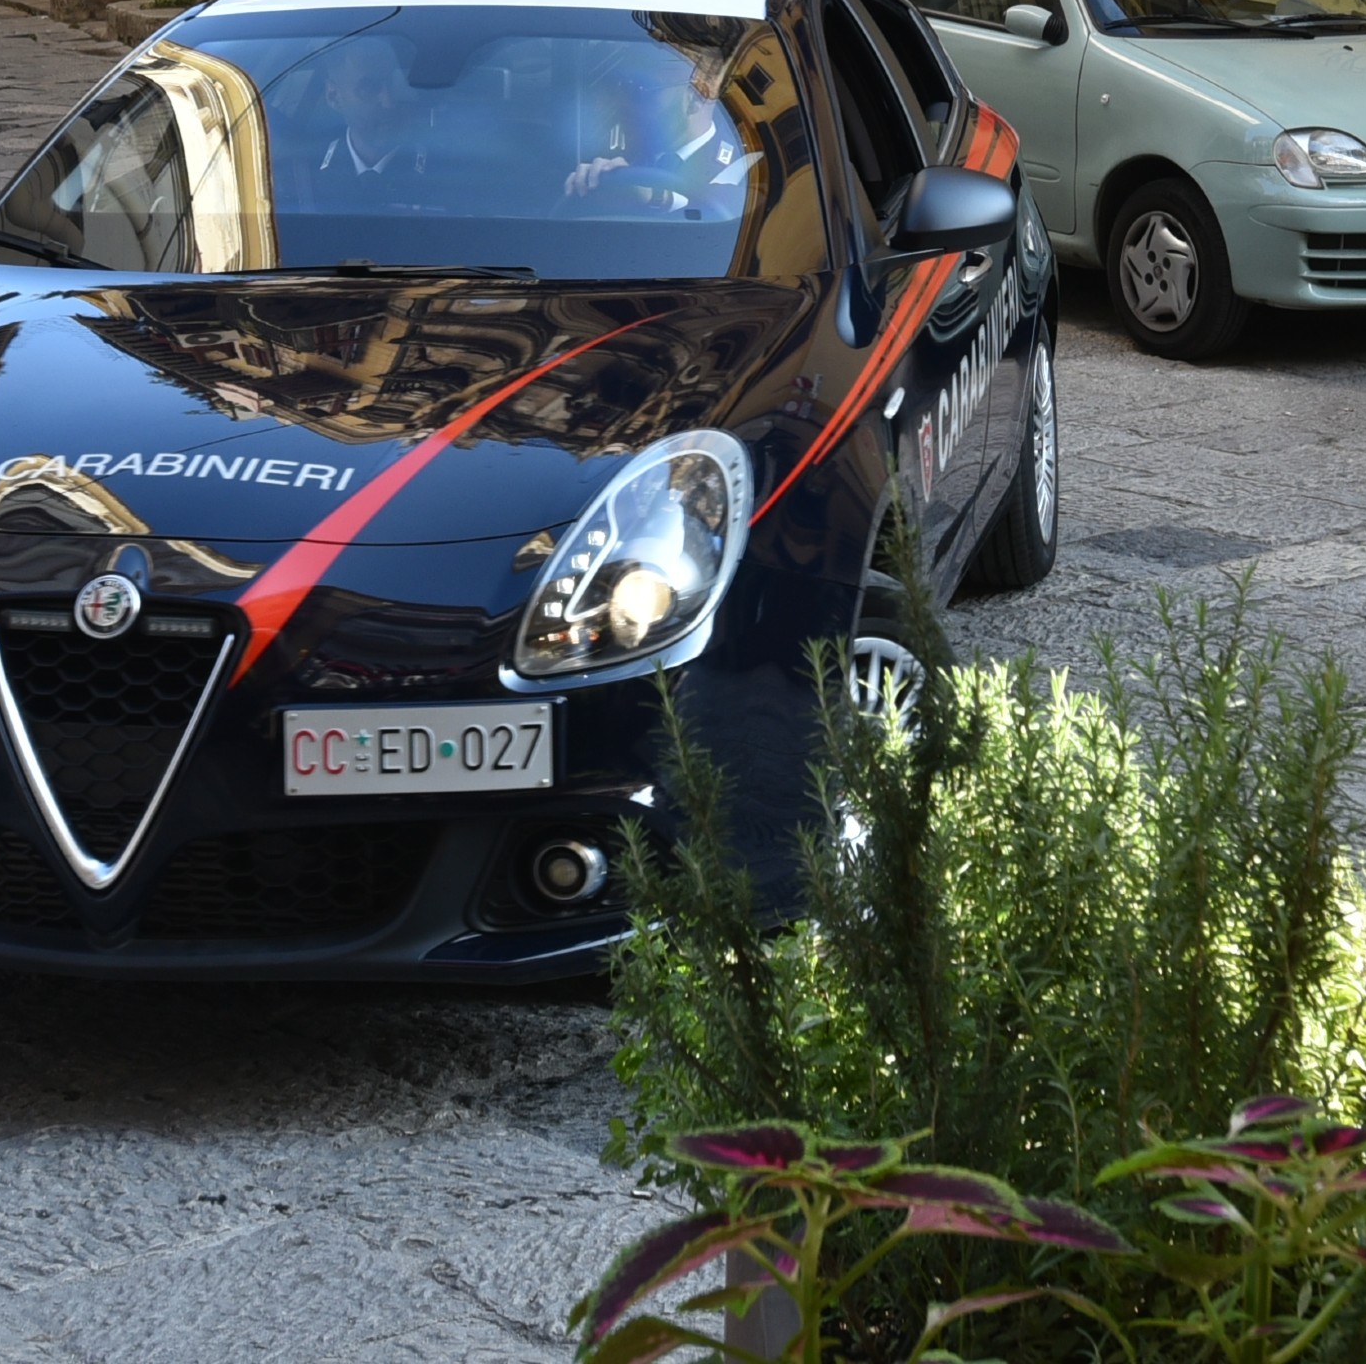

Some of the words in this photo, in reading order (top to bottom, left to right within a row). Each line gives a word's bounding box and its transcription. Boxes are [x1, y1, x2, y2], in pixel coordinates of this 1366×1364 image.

[938, 256, 1021, 472] CARABINIERI
[292, 728, 348, 776] CC
[378, 725, 434, 775] ED
[461, 721, 546, 772] 027
